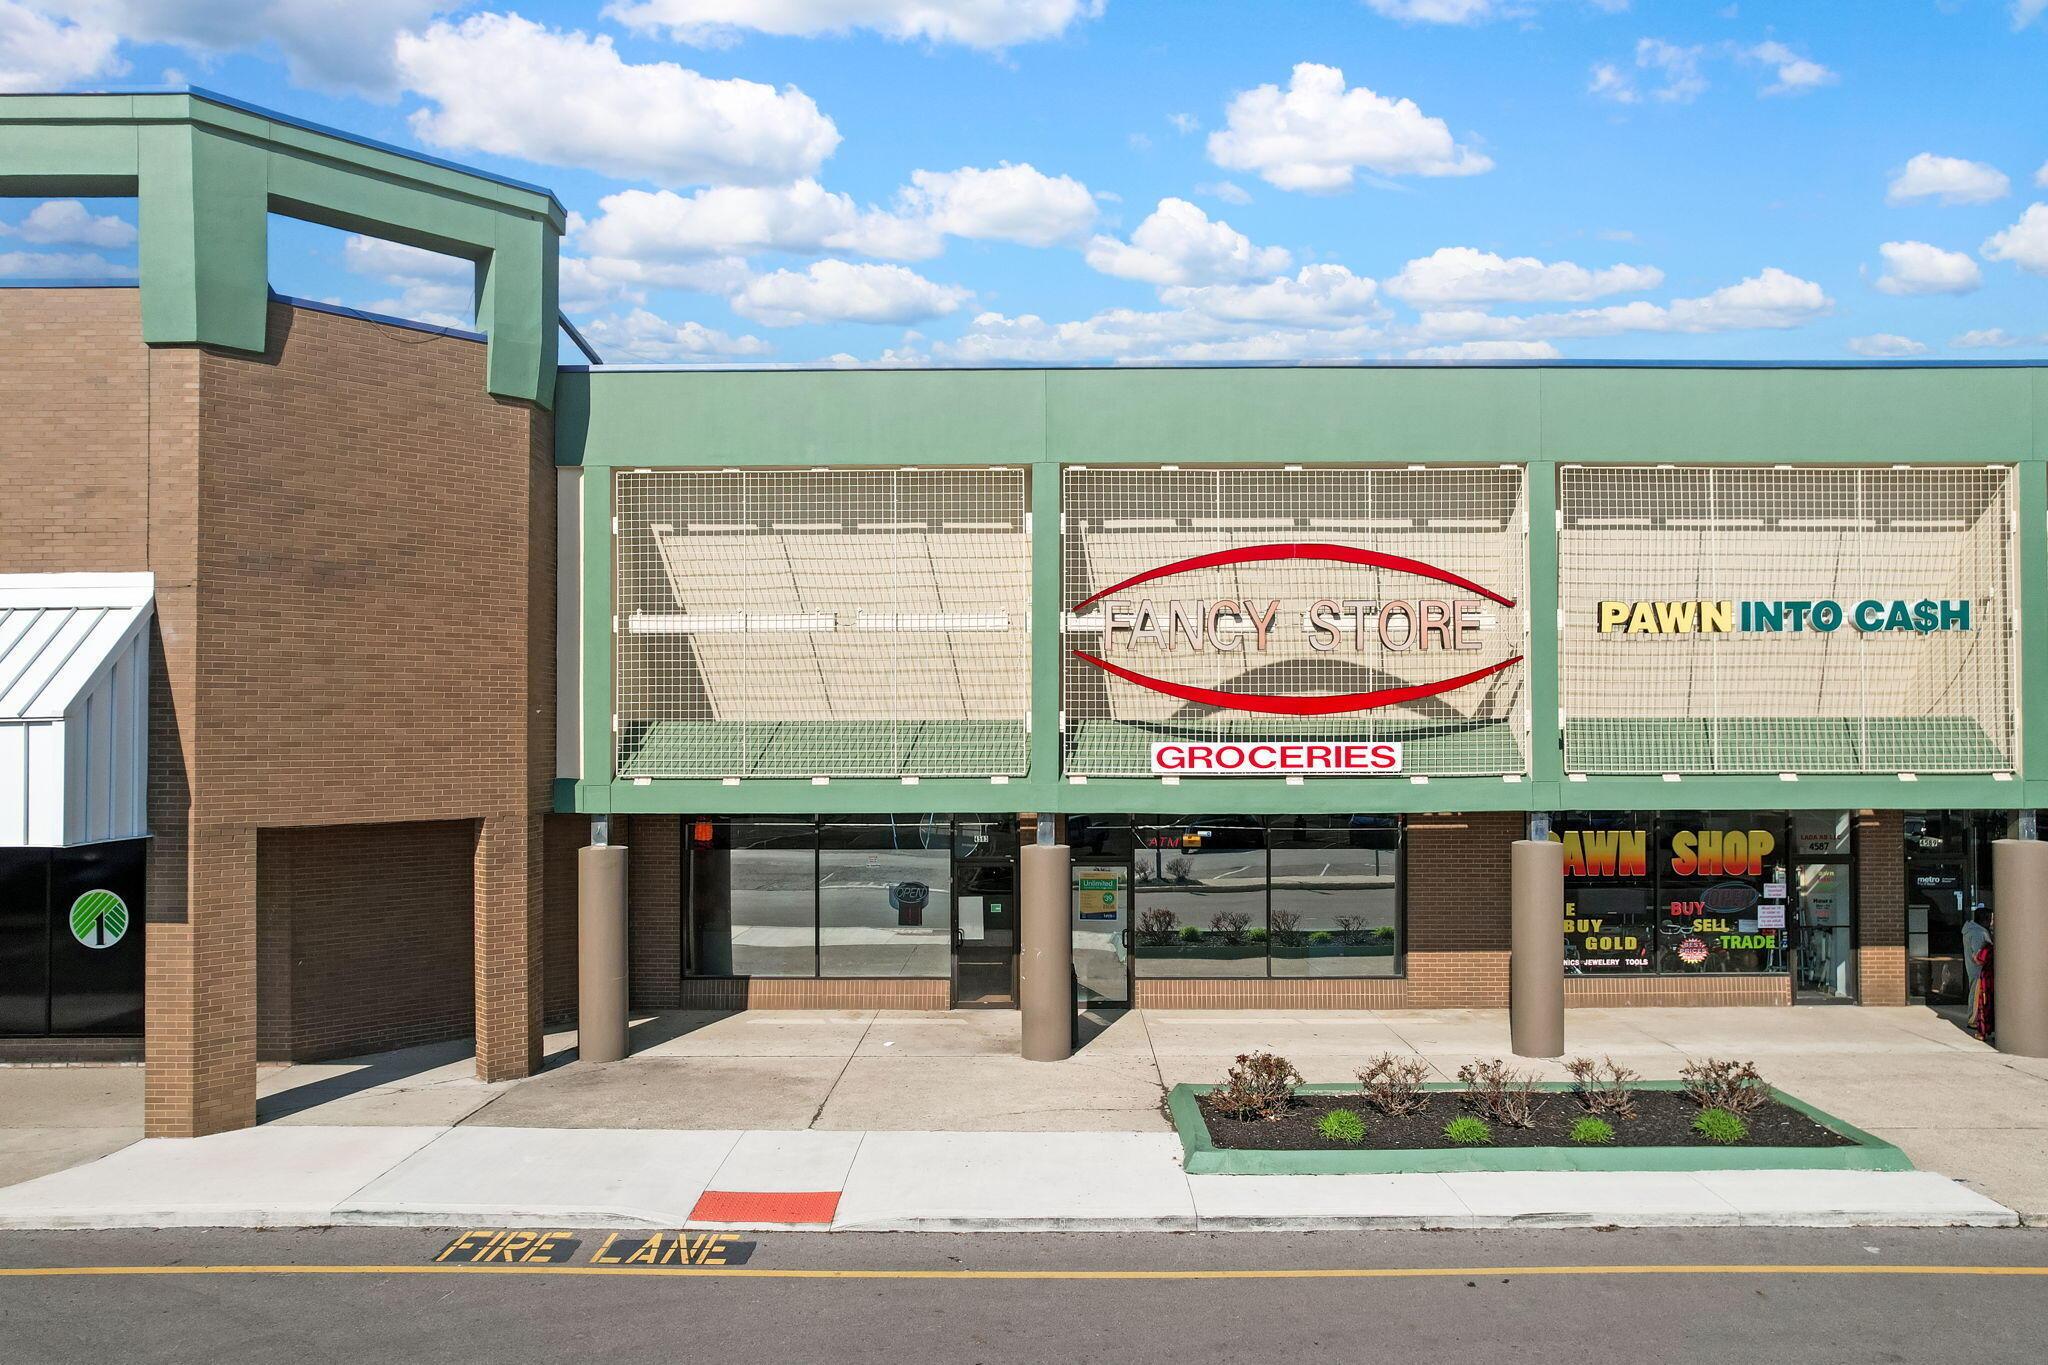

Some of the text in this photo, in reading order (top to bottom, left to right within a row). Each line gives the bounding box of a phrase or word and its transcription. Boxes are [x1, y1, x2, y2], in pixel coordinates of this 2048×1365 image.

[1597, 598, 1971, 635] PAWN INTO CA$H
[1103, 599, 1483, 652] FANCY STORE
[1155, 744, 1397, 769] GROCERIES
[1149, 836, 1181, 848] ATM
[1809, 842, 1830, 851] 4587
[1670, 830, 1776, 877] SHOP
[896, 887, 925, 898] OPEN
[1670, 901, 1706, 916] BUY
[1563, 919, 1603, 933] BUY
[1692, 918, 1730, 932] SELL
[1585, 936, 1638, 950] GOLD
[1720, 935, 1776, 950] TRADE
[1583, 958, 1620, 966] JEWELERY
[1624, 958, 1649, 967] TOOLS
[434, 1230, 742, 1266] FIRE LANE
